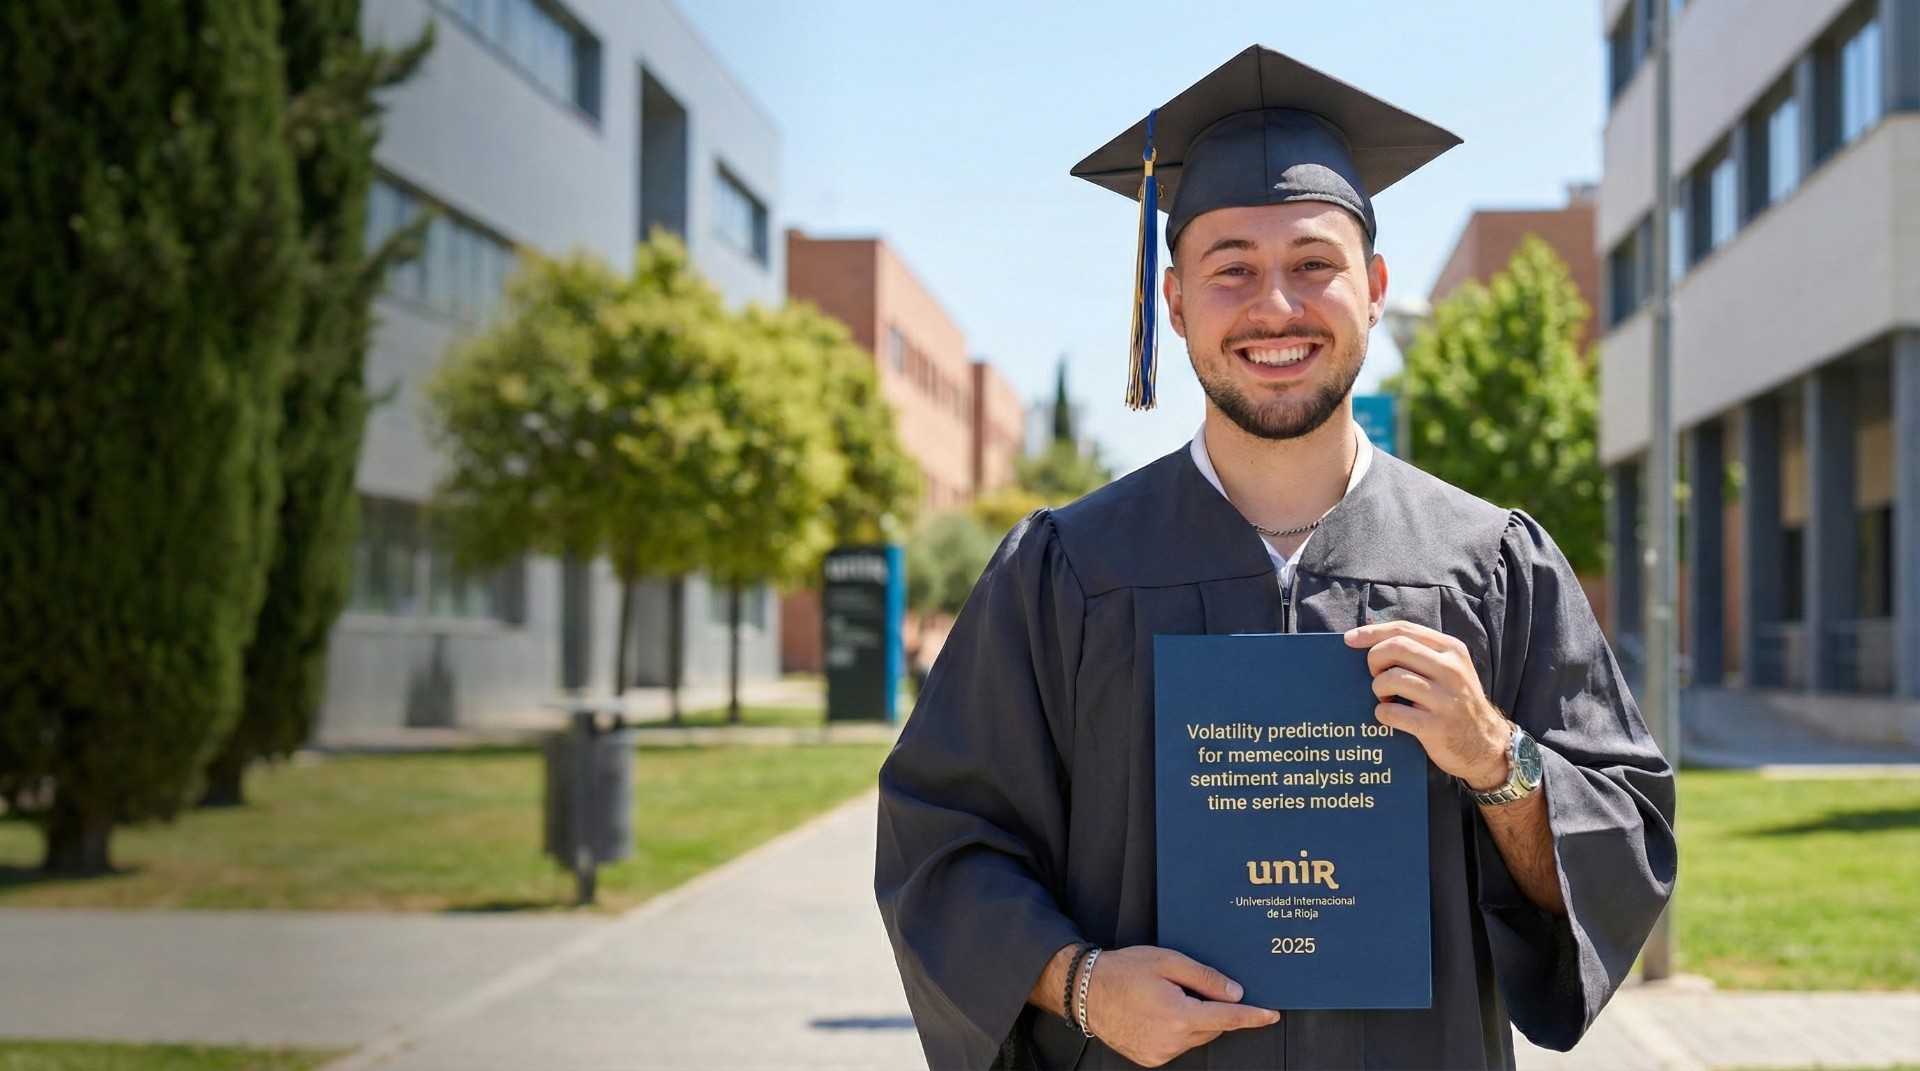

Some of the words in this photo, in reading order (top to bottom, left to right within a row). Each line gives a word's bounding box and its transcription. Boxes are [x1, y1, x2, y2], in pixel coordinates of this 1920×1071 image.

[1187, 722, 1263, 742] Volatility
[1268, 721, 1356, 742] prediction
[1198, 746, 1223, 763] for
[1228, 745, 1330, 763] memecoins
[1335, 745, 1383, 765] using
[1190, 770, 1278, 787] sentiment
[1283, 768, 1355, 789] analysis
[1359, 768, 1392, 785] and
[1207, 795, 1247, 810] time
[1252, 794, 1305, 810] series
[1310, 793, 1375, 809] models
[1293, 896, 1356, 906] Internacional
[1267, 909, 1279, 918] de
[1281, 909, 1293, 918] La
[1294, 908, 1319, 920] Rioja
[1271, 937, 1316, 954] 2025
